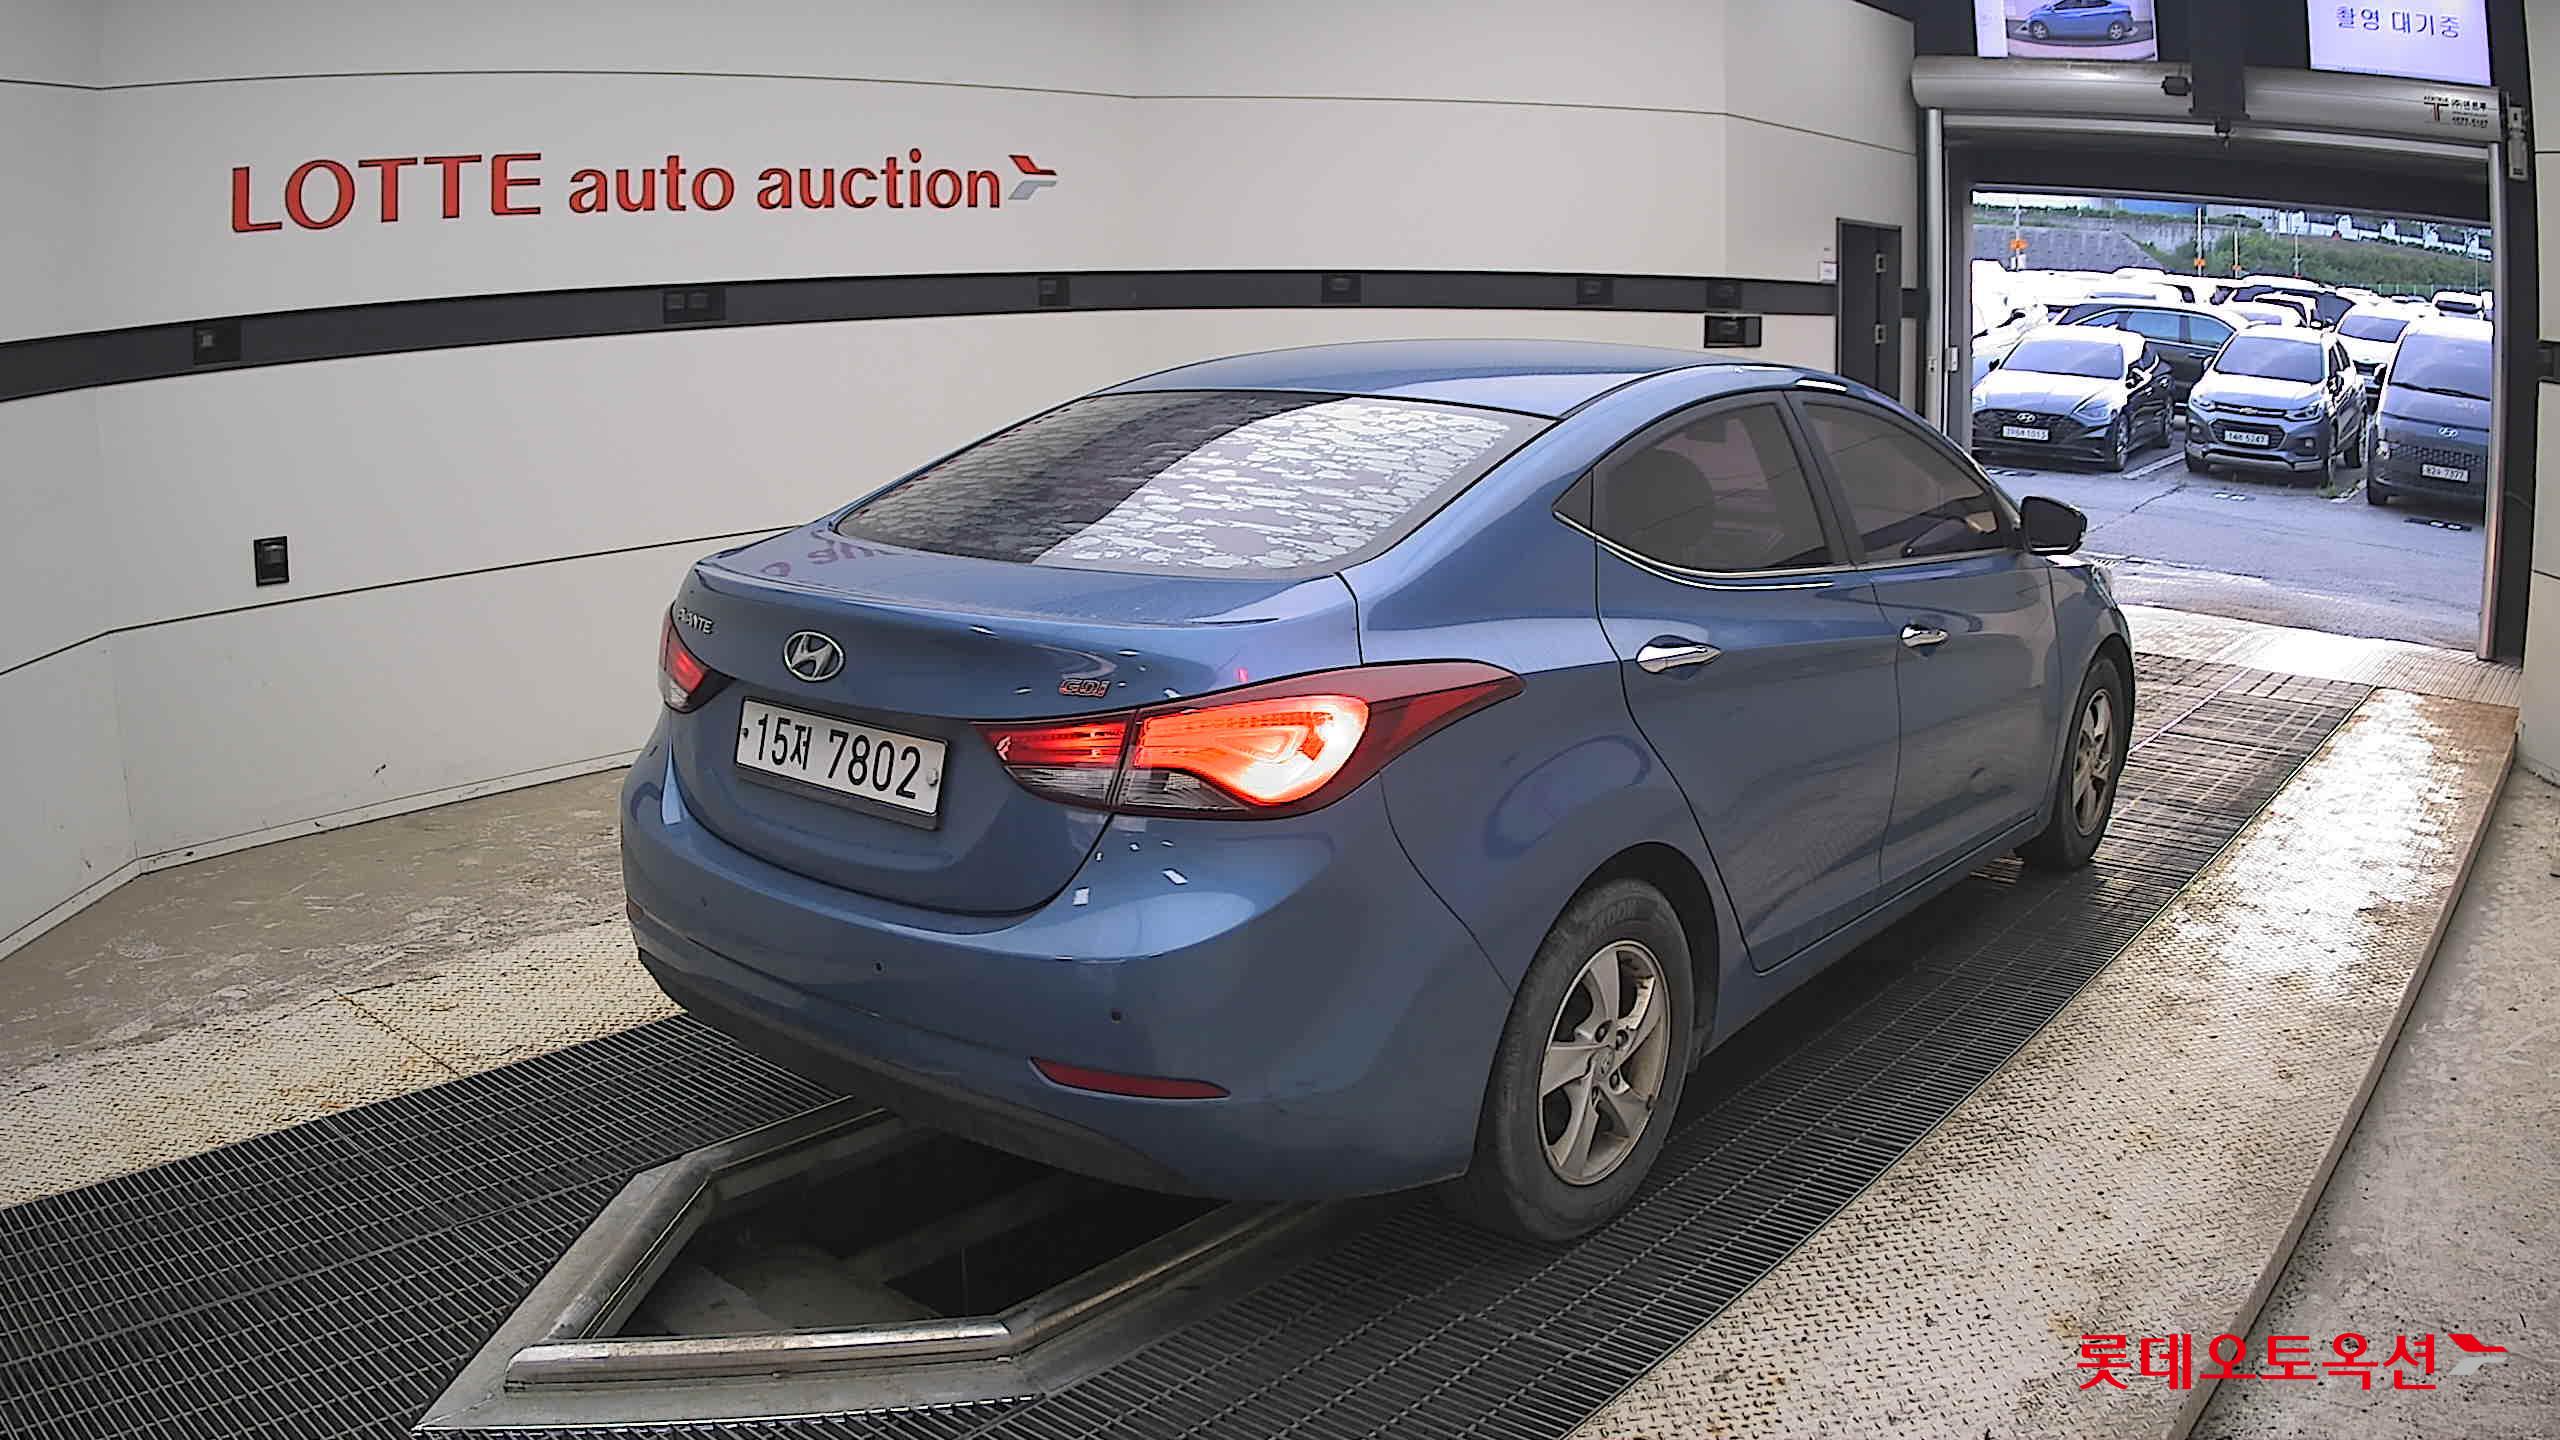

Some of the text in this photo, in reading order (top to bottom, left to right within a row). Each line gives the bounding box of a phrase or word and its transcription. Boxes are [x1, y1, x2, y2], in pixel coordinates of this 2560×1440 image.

[2391, 11, 2459, 38] 대기중
[233, 150, 1000, 232] LOTTE auto auction
[757, 713, 921, 800] 15저 7802
